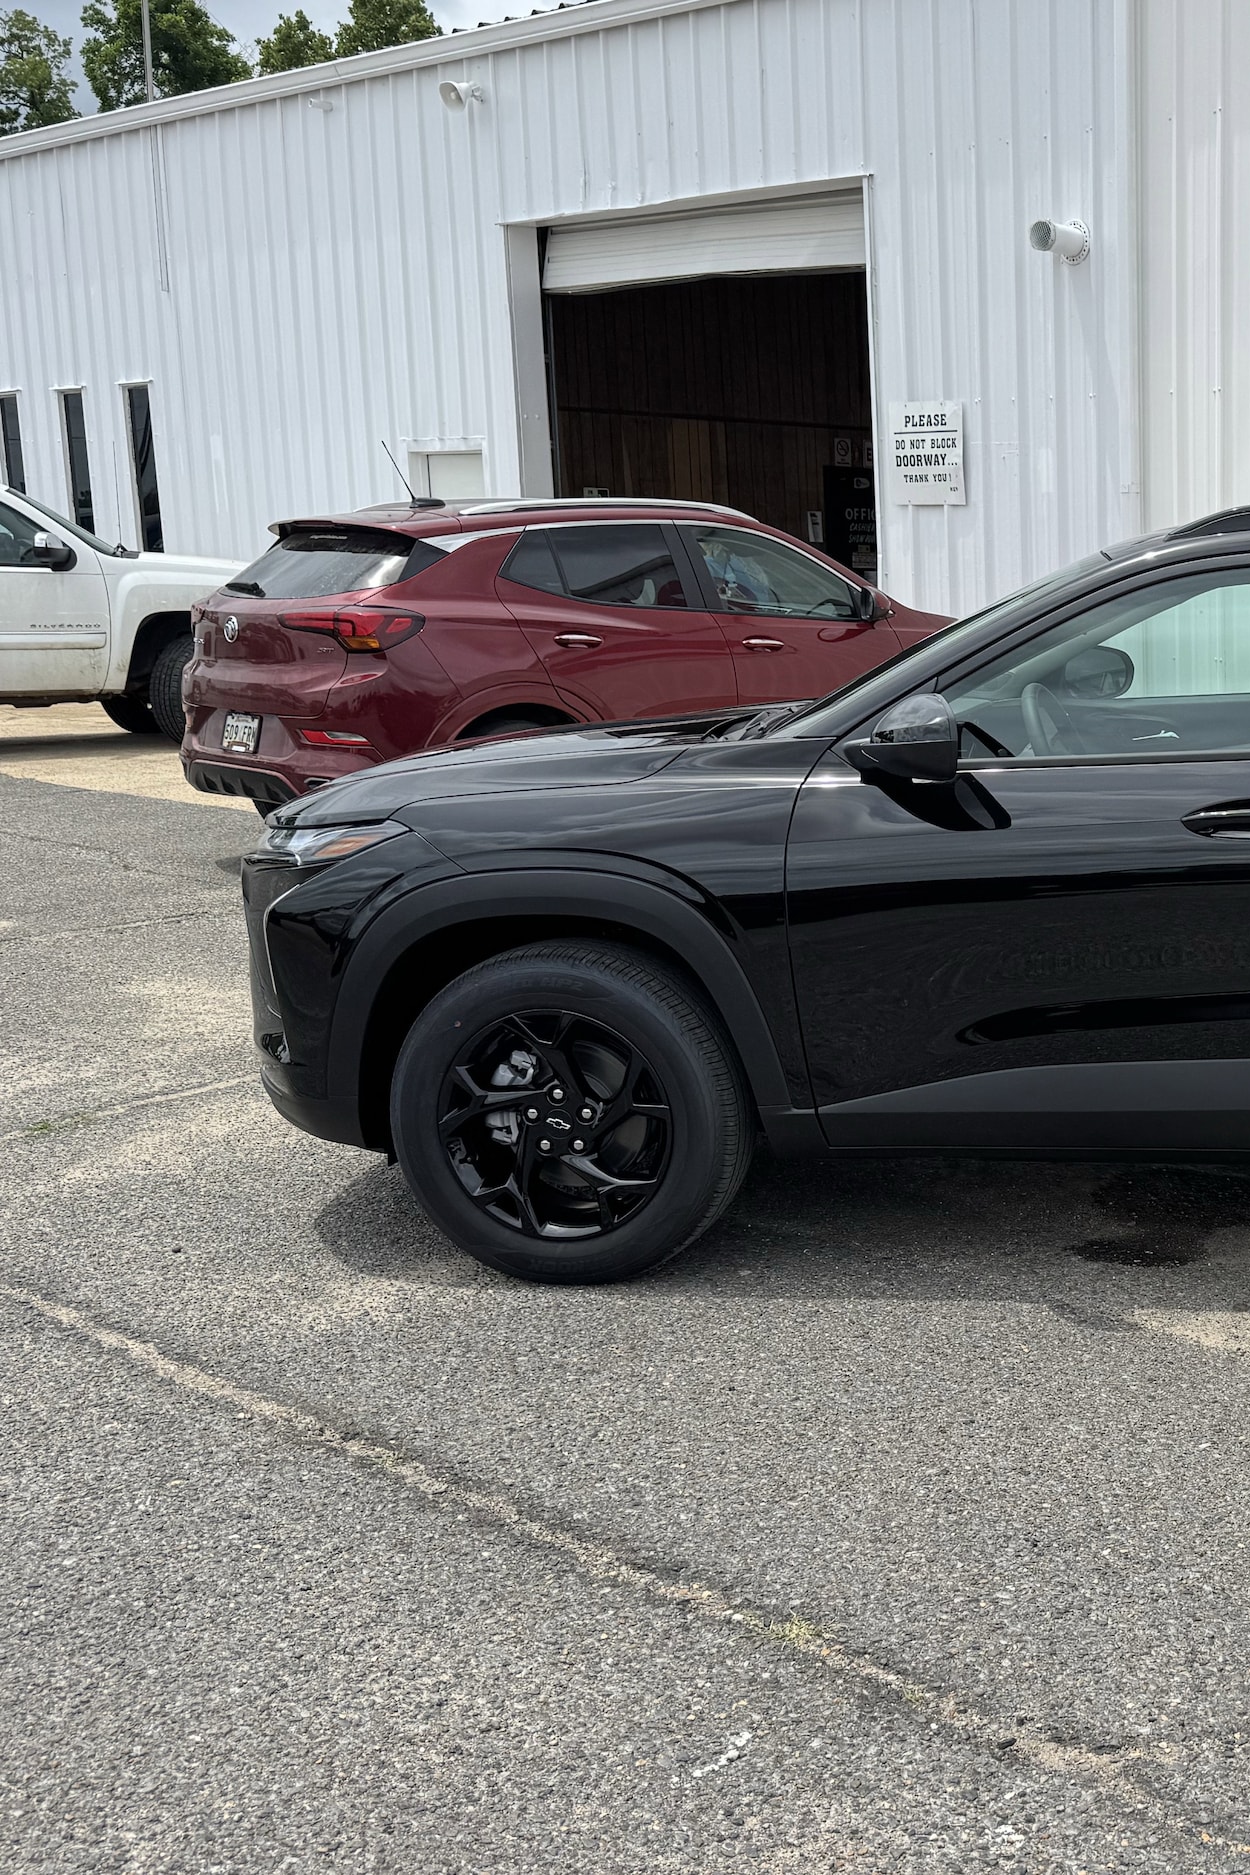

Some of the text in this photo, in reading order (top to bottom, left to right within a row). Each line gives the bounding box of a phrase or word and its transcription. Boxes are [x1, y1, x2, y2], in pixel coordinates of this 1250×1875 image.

[904, 413, 947, 428] PLEASE
[895, 437, 957, 450] DO NOT BLOCK
[895, 453, 958, 468] DOORWAY...
[904, 473, 929, 483] THANK
